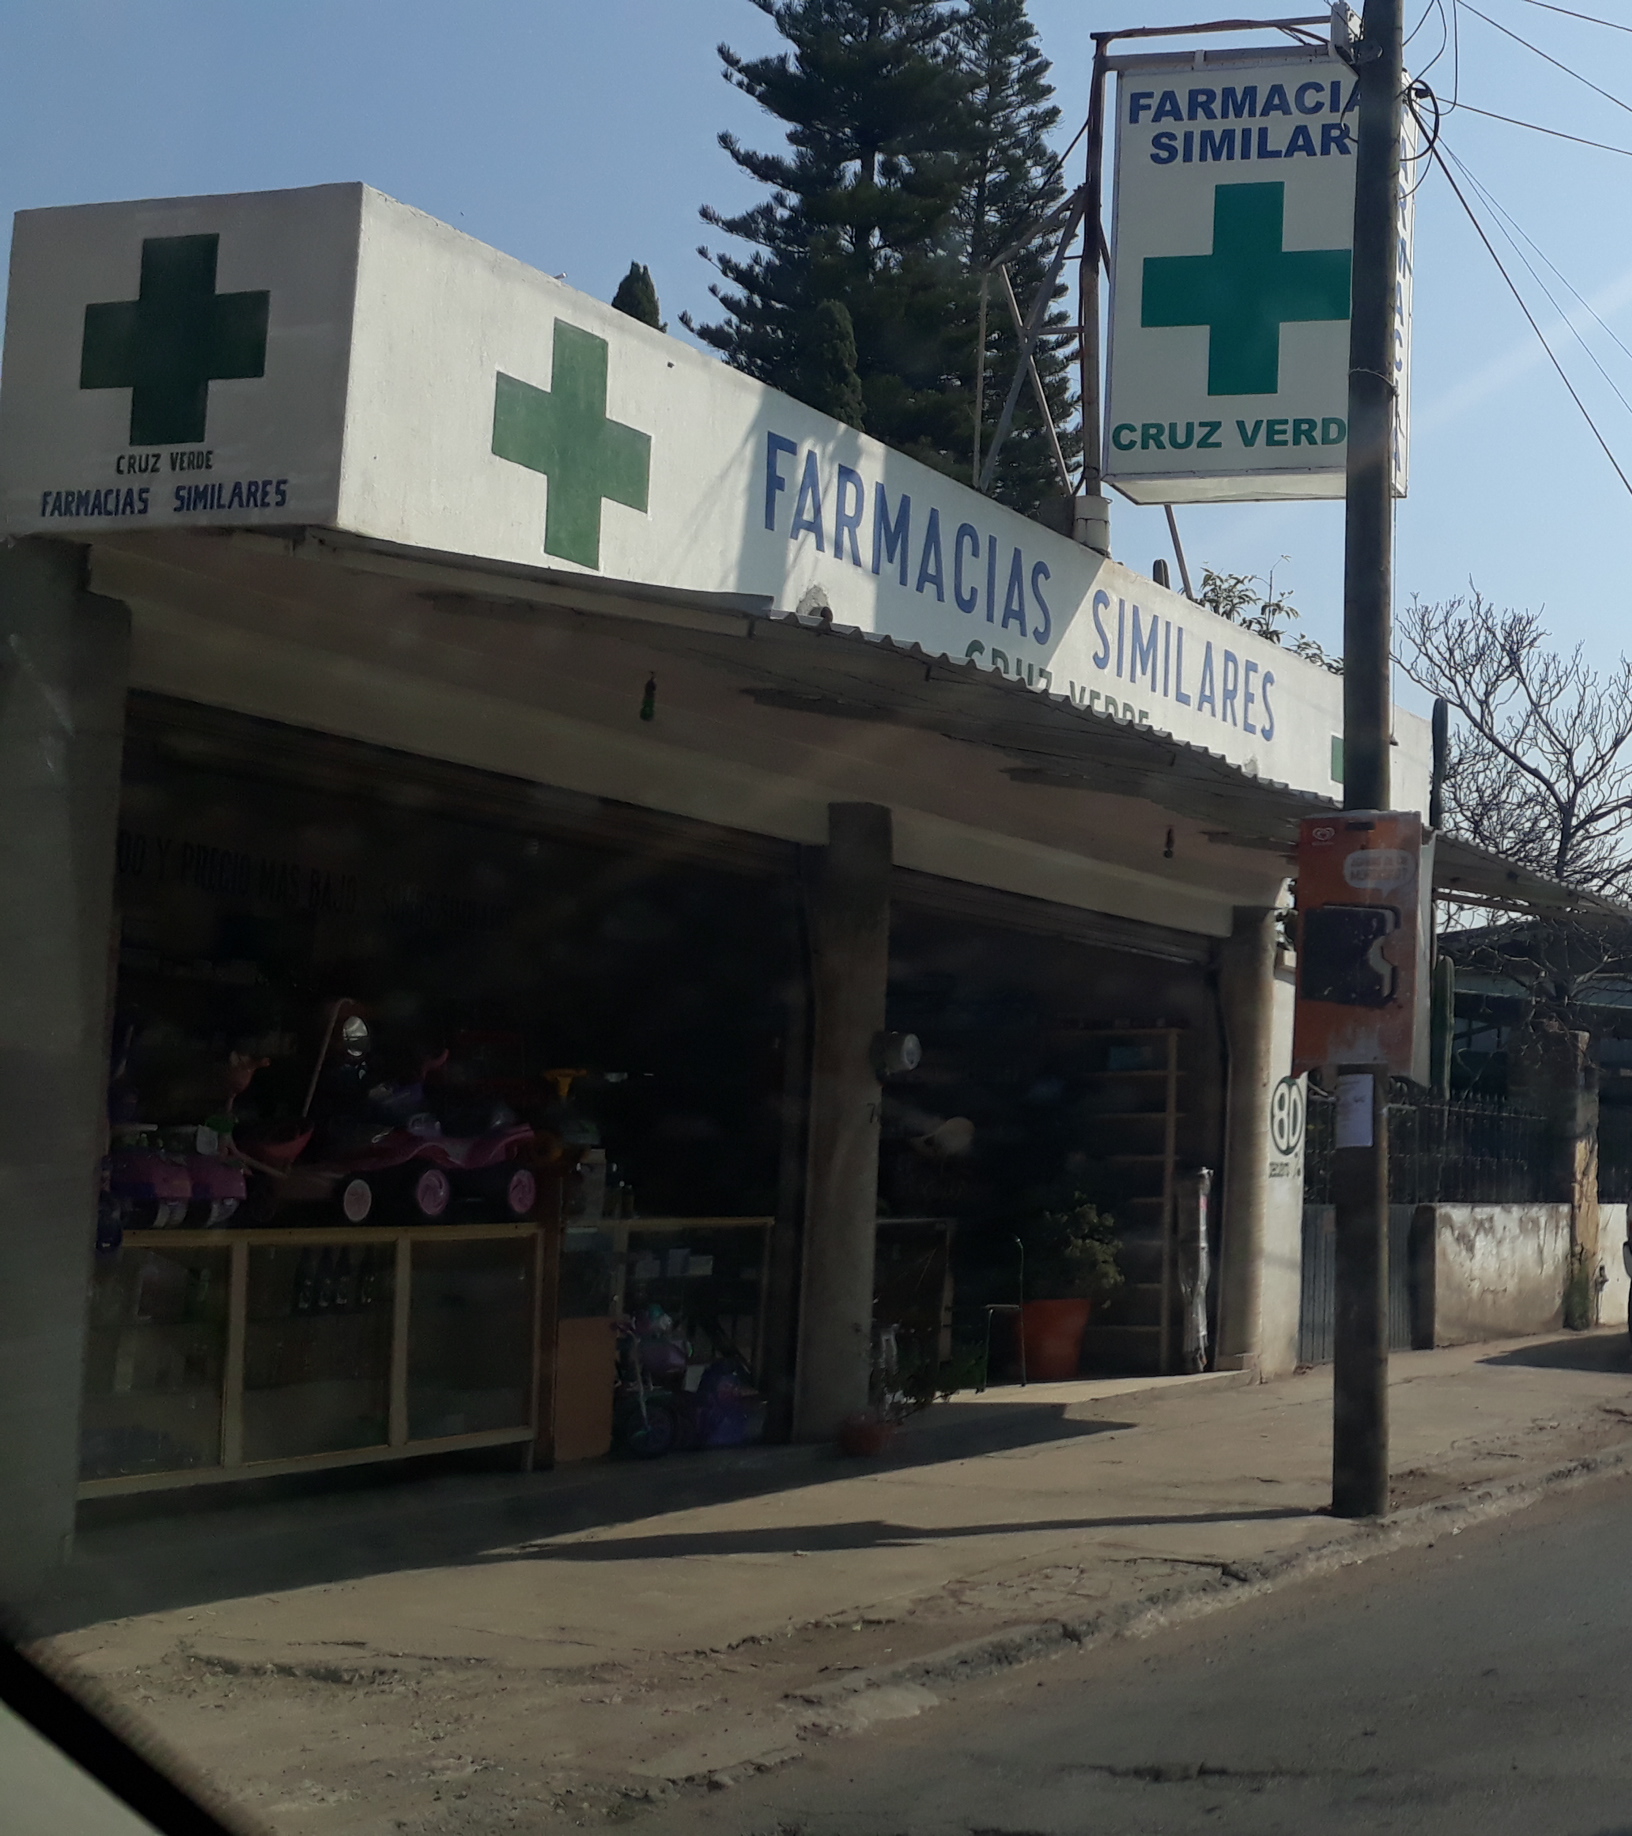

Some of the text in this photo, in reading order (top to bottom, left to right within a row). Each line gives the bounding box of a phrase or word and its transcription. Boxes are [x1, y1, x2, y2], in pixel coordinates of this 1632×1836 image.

[1111, 420, 1223, 452] CRUZ
[116, 449, 214, 474] CRUZ VERDE
[41, 478, 289, 518] FARMACIAS SIMILARES
[765, 430, 1276, 742] FARMACIAS SIMILARES
[307, 867, 359, 916] BAJO
